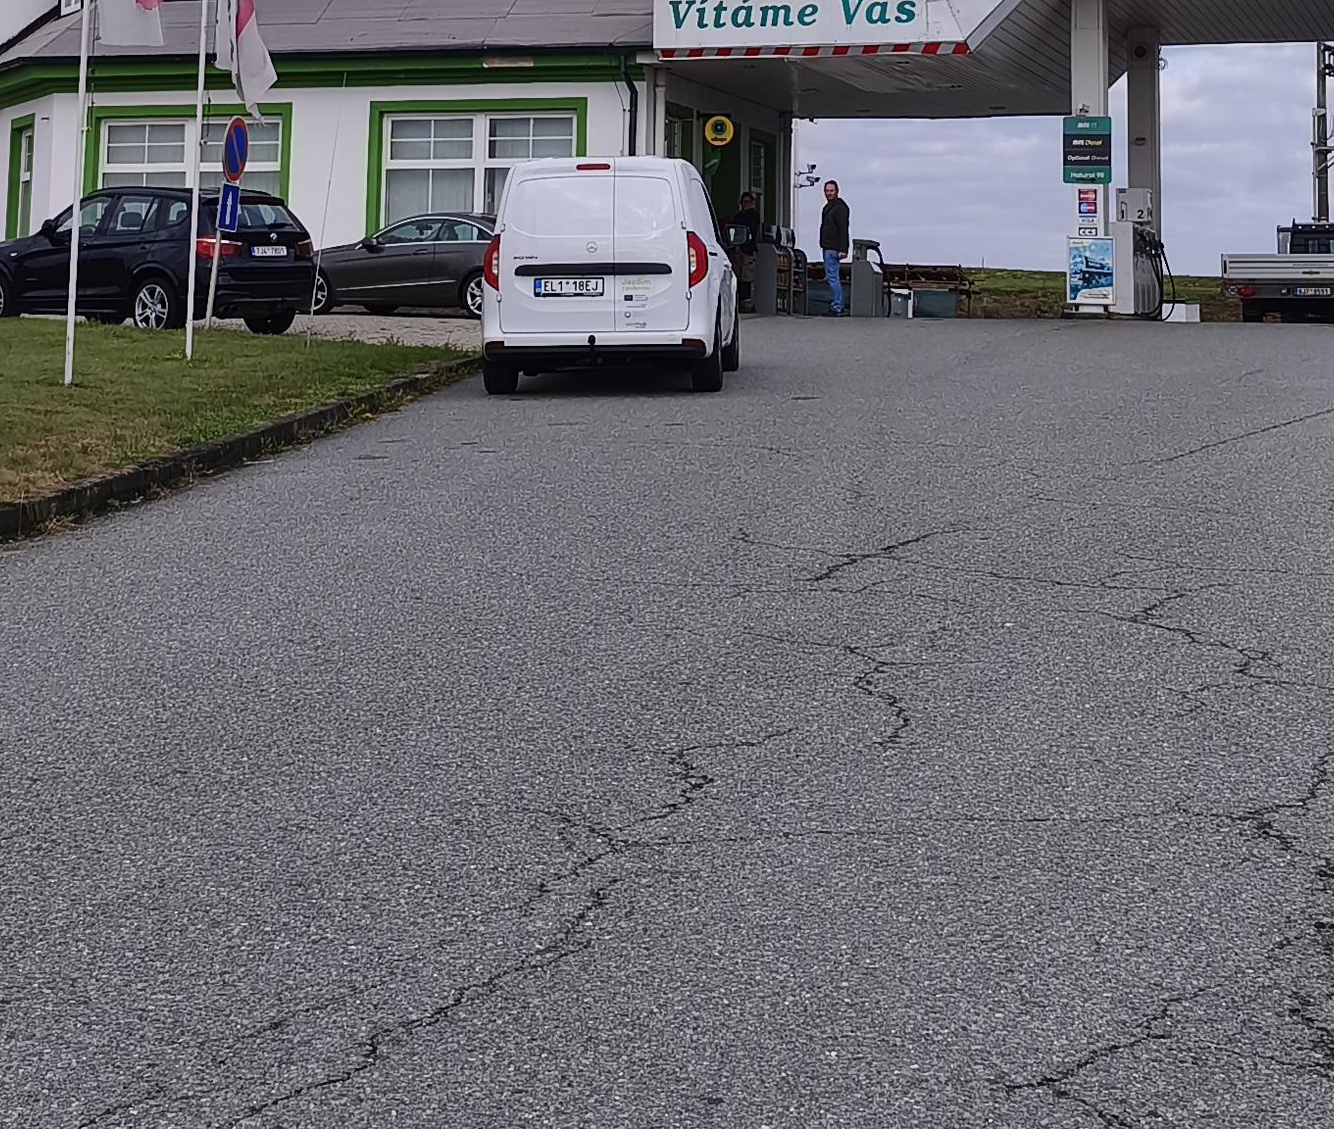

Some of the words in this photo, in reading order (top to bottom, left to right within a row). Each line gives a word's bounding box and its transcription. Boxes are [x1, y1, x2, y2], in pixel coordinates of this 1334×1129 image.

[1070, 171, 1095, 179] Natural
[1136, 209, 1144, 219] 2
[1079, 228, 1097, 236] CCS
[543, 280, 563, 292] EL1
[572, 280, 599, 292] 18EJ
